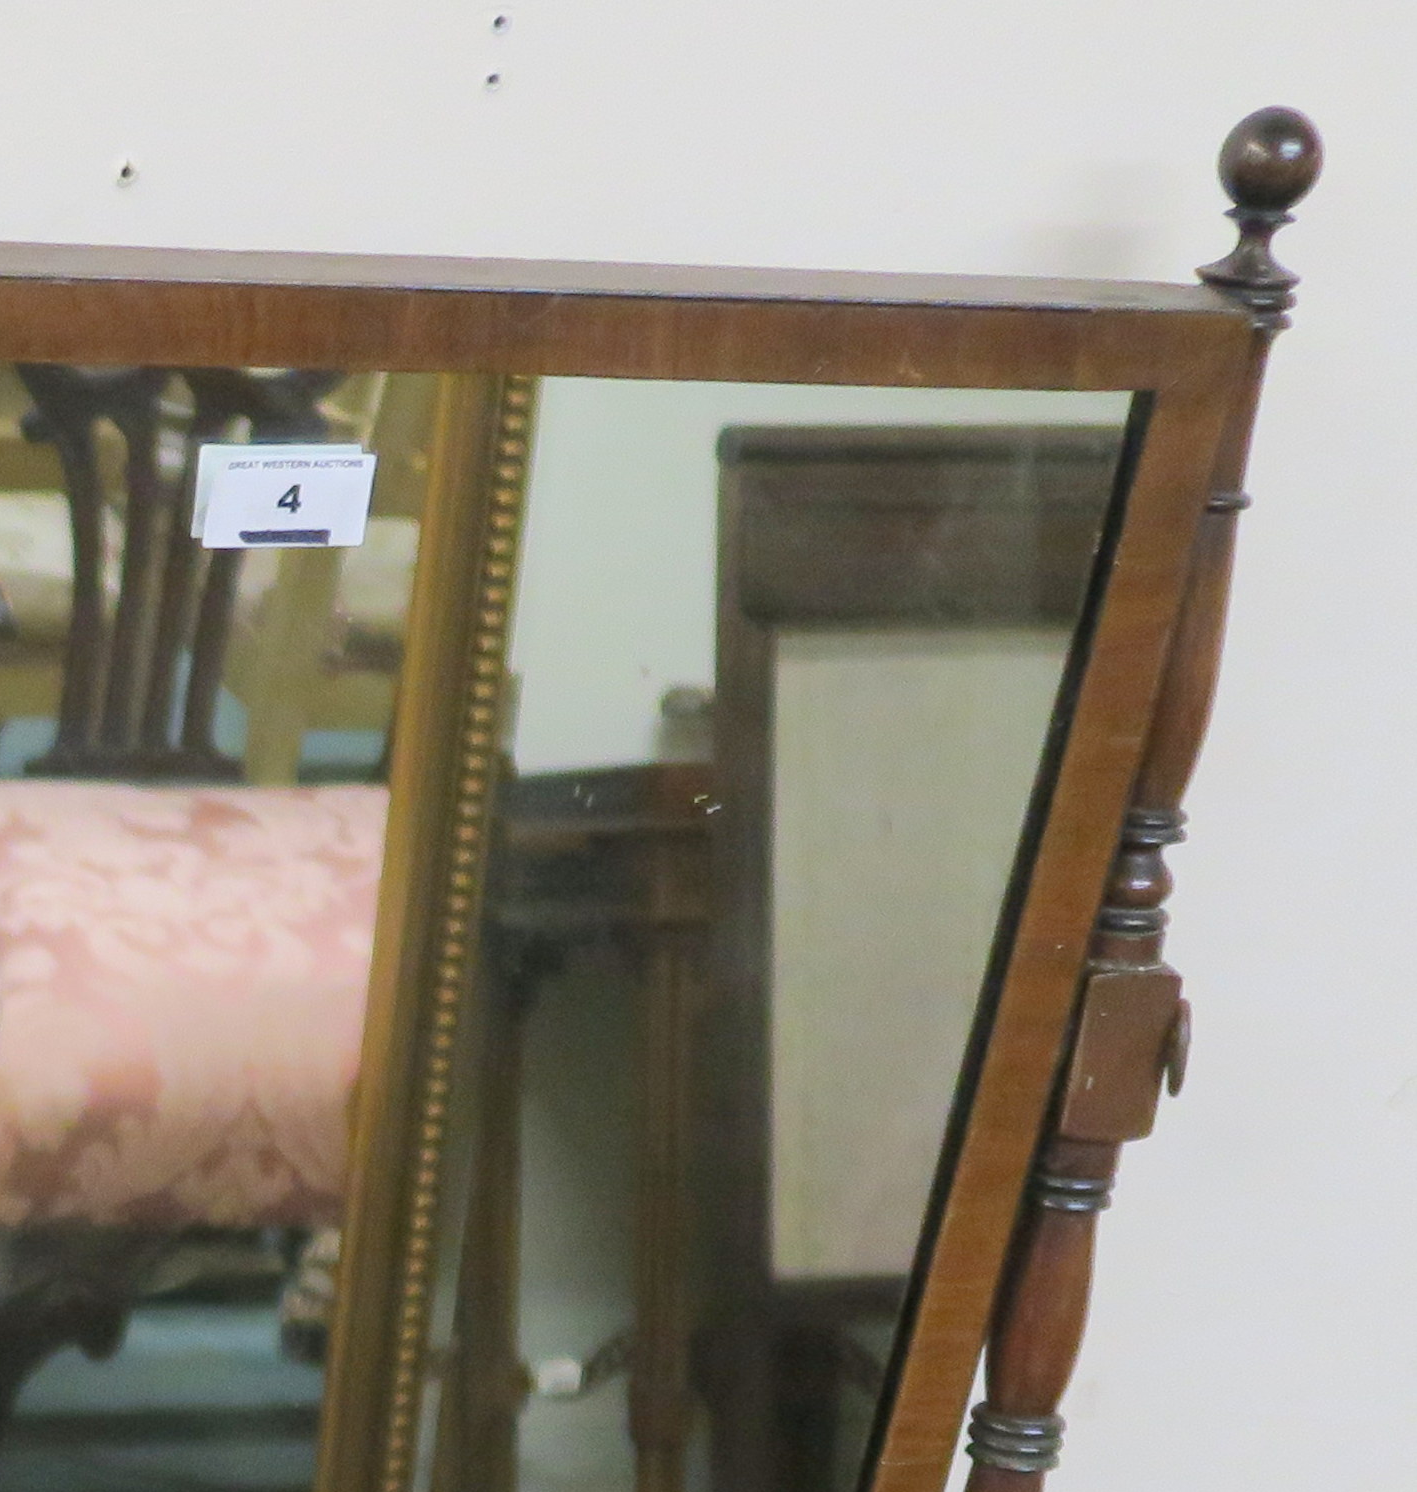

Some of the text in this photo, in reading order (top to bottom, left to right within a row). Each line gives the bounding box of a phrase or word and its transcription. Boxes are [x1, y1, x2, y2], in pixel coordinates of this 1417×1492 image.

[262, 460, 311, 470] WESTERN
[312, 459, 365, 469] AUCTIONS
[276, 483, 302, 514] 4
